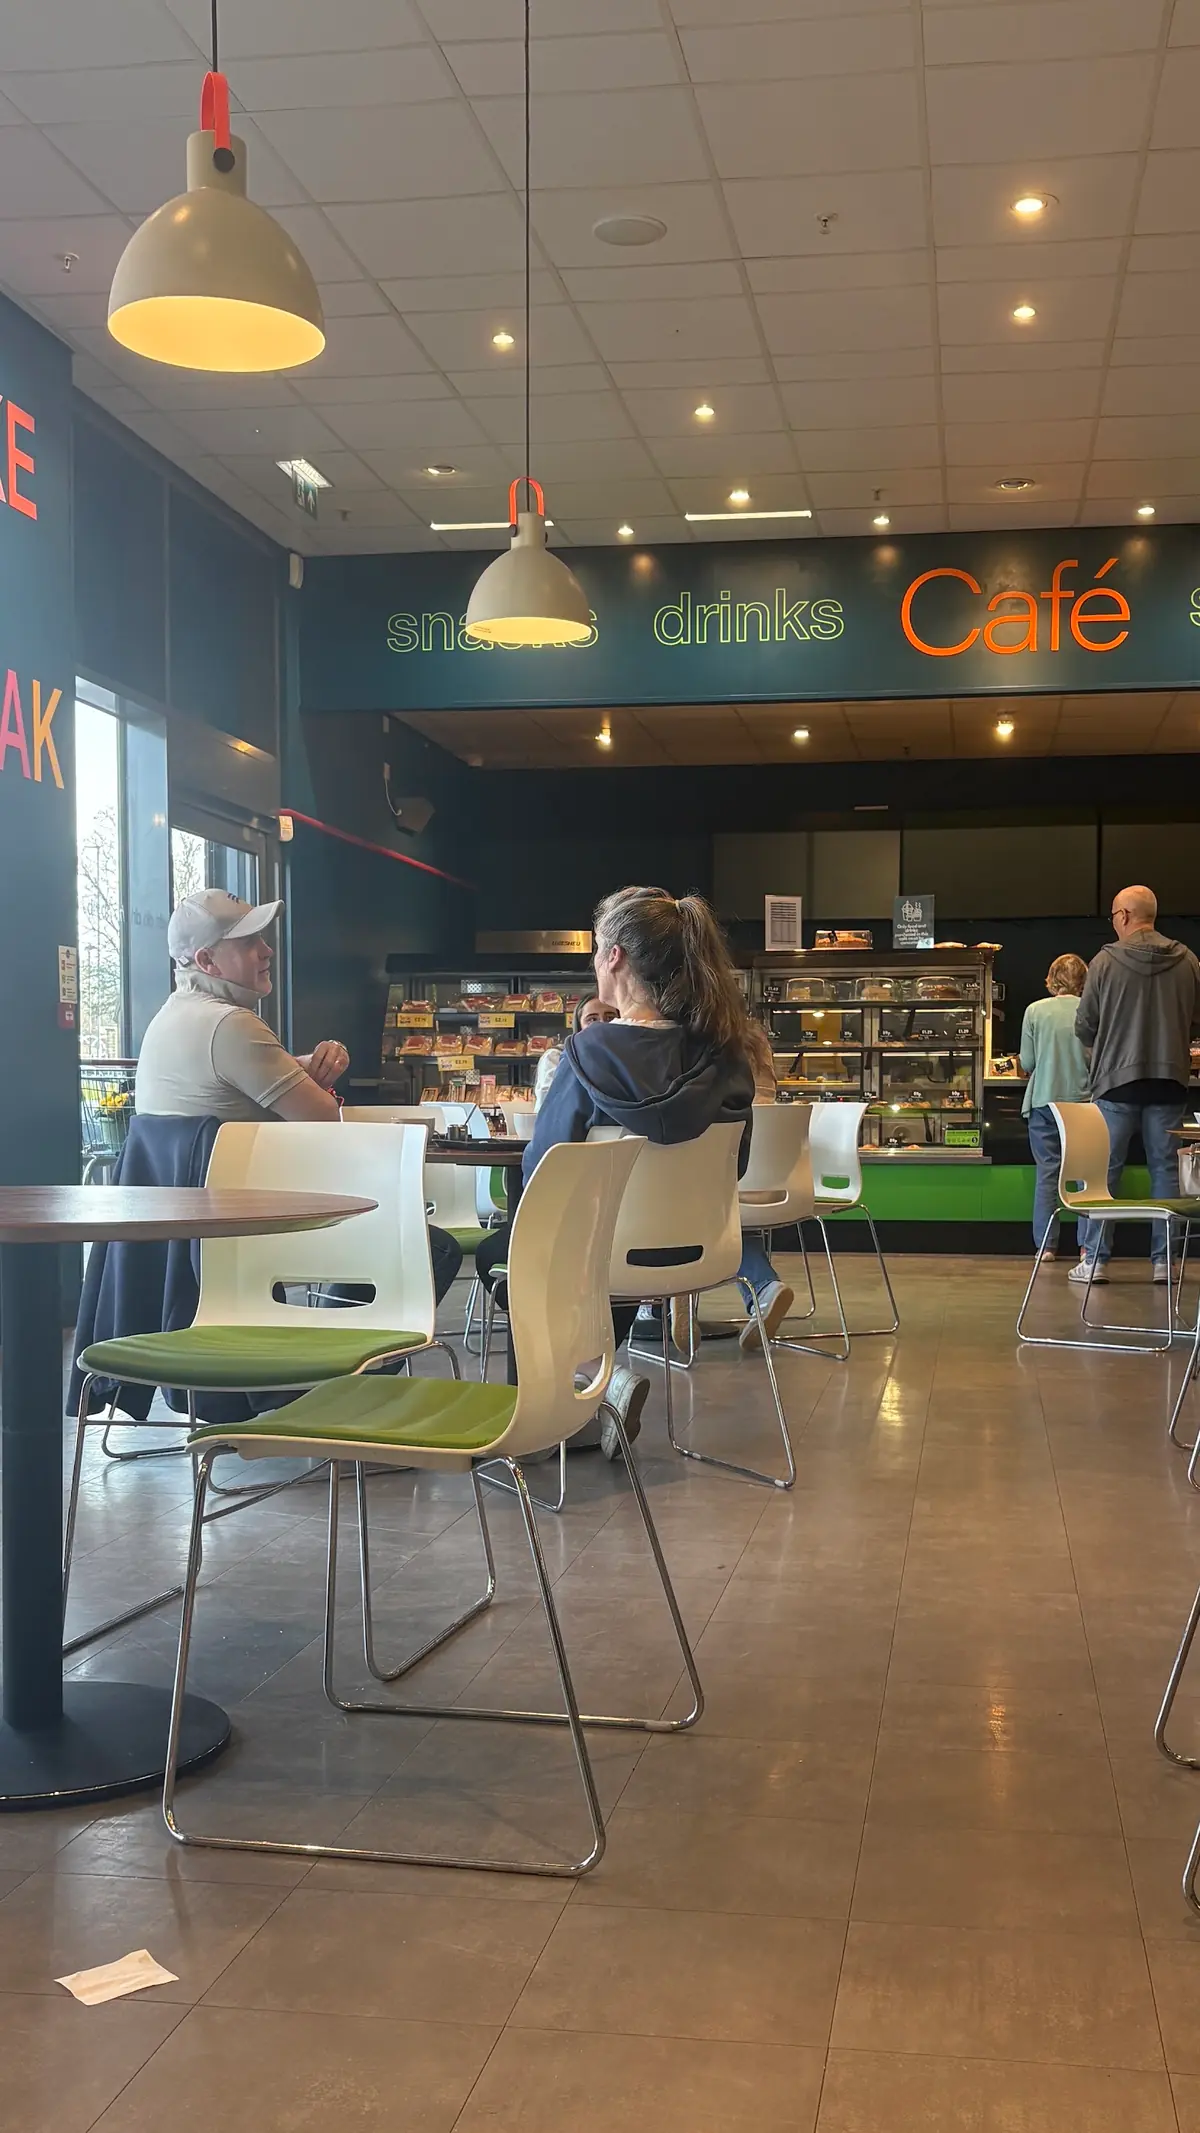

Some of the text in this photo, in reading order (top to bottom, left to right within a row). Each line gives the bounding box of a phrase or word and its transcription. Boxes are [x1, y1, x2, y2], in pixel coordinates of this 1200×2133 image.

[0, 394, 37, 520] E
[387, 609, 599, 652] snas
[653, 588, 845, 645] drinks
[900, 557, 1131, 657] Café
